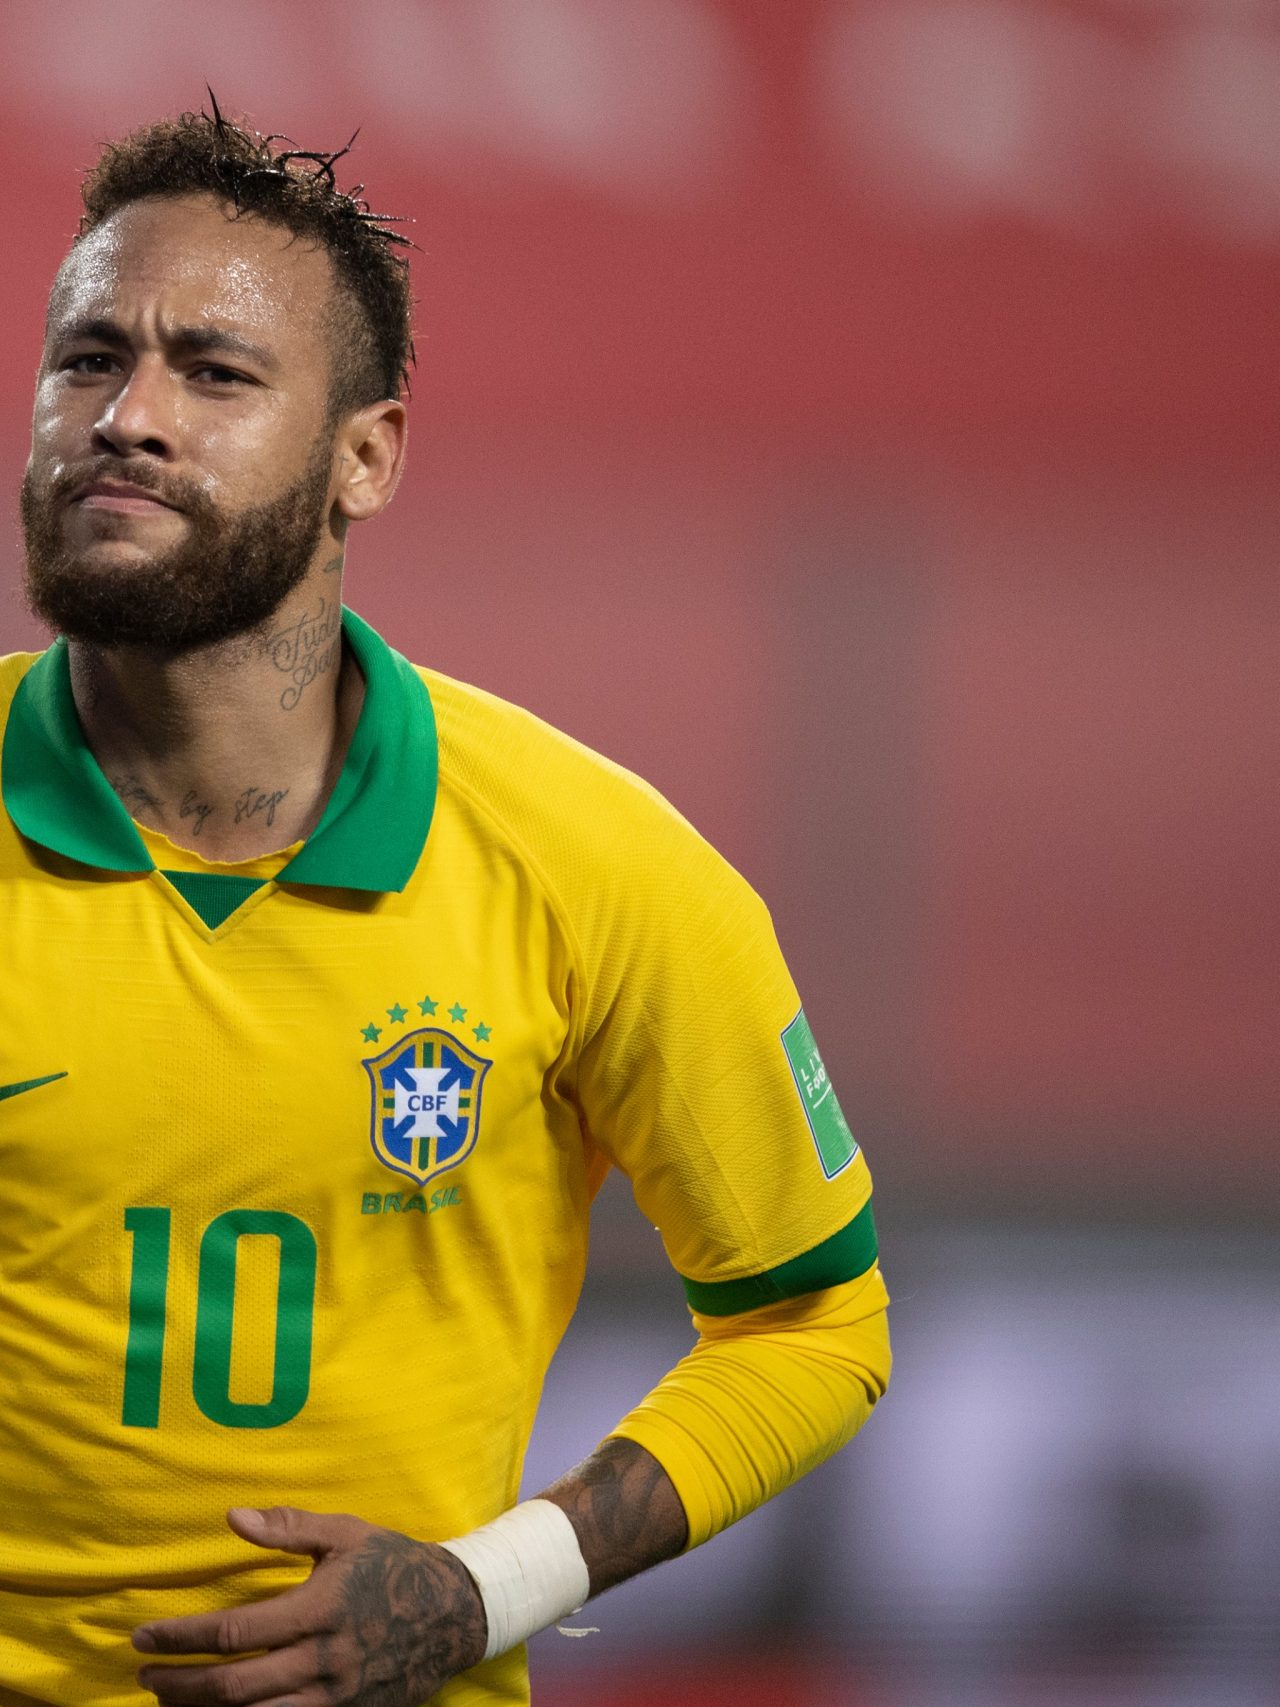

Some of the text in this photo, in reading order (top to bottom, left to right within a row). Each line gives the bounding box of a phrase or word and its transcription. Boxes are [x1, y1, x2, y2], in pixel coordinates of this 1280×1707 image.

[179, 789, 216, 836] by
[234, 786, 290, 828] step
[805, 1062, 827, 1099] FOO
[407, 1094, 448, 1112] CBF
[360, 1185, 464, 1216] BRASIL
[121, 1206, 318, 1430] 10
